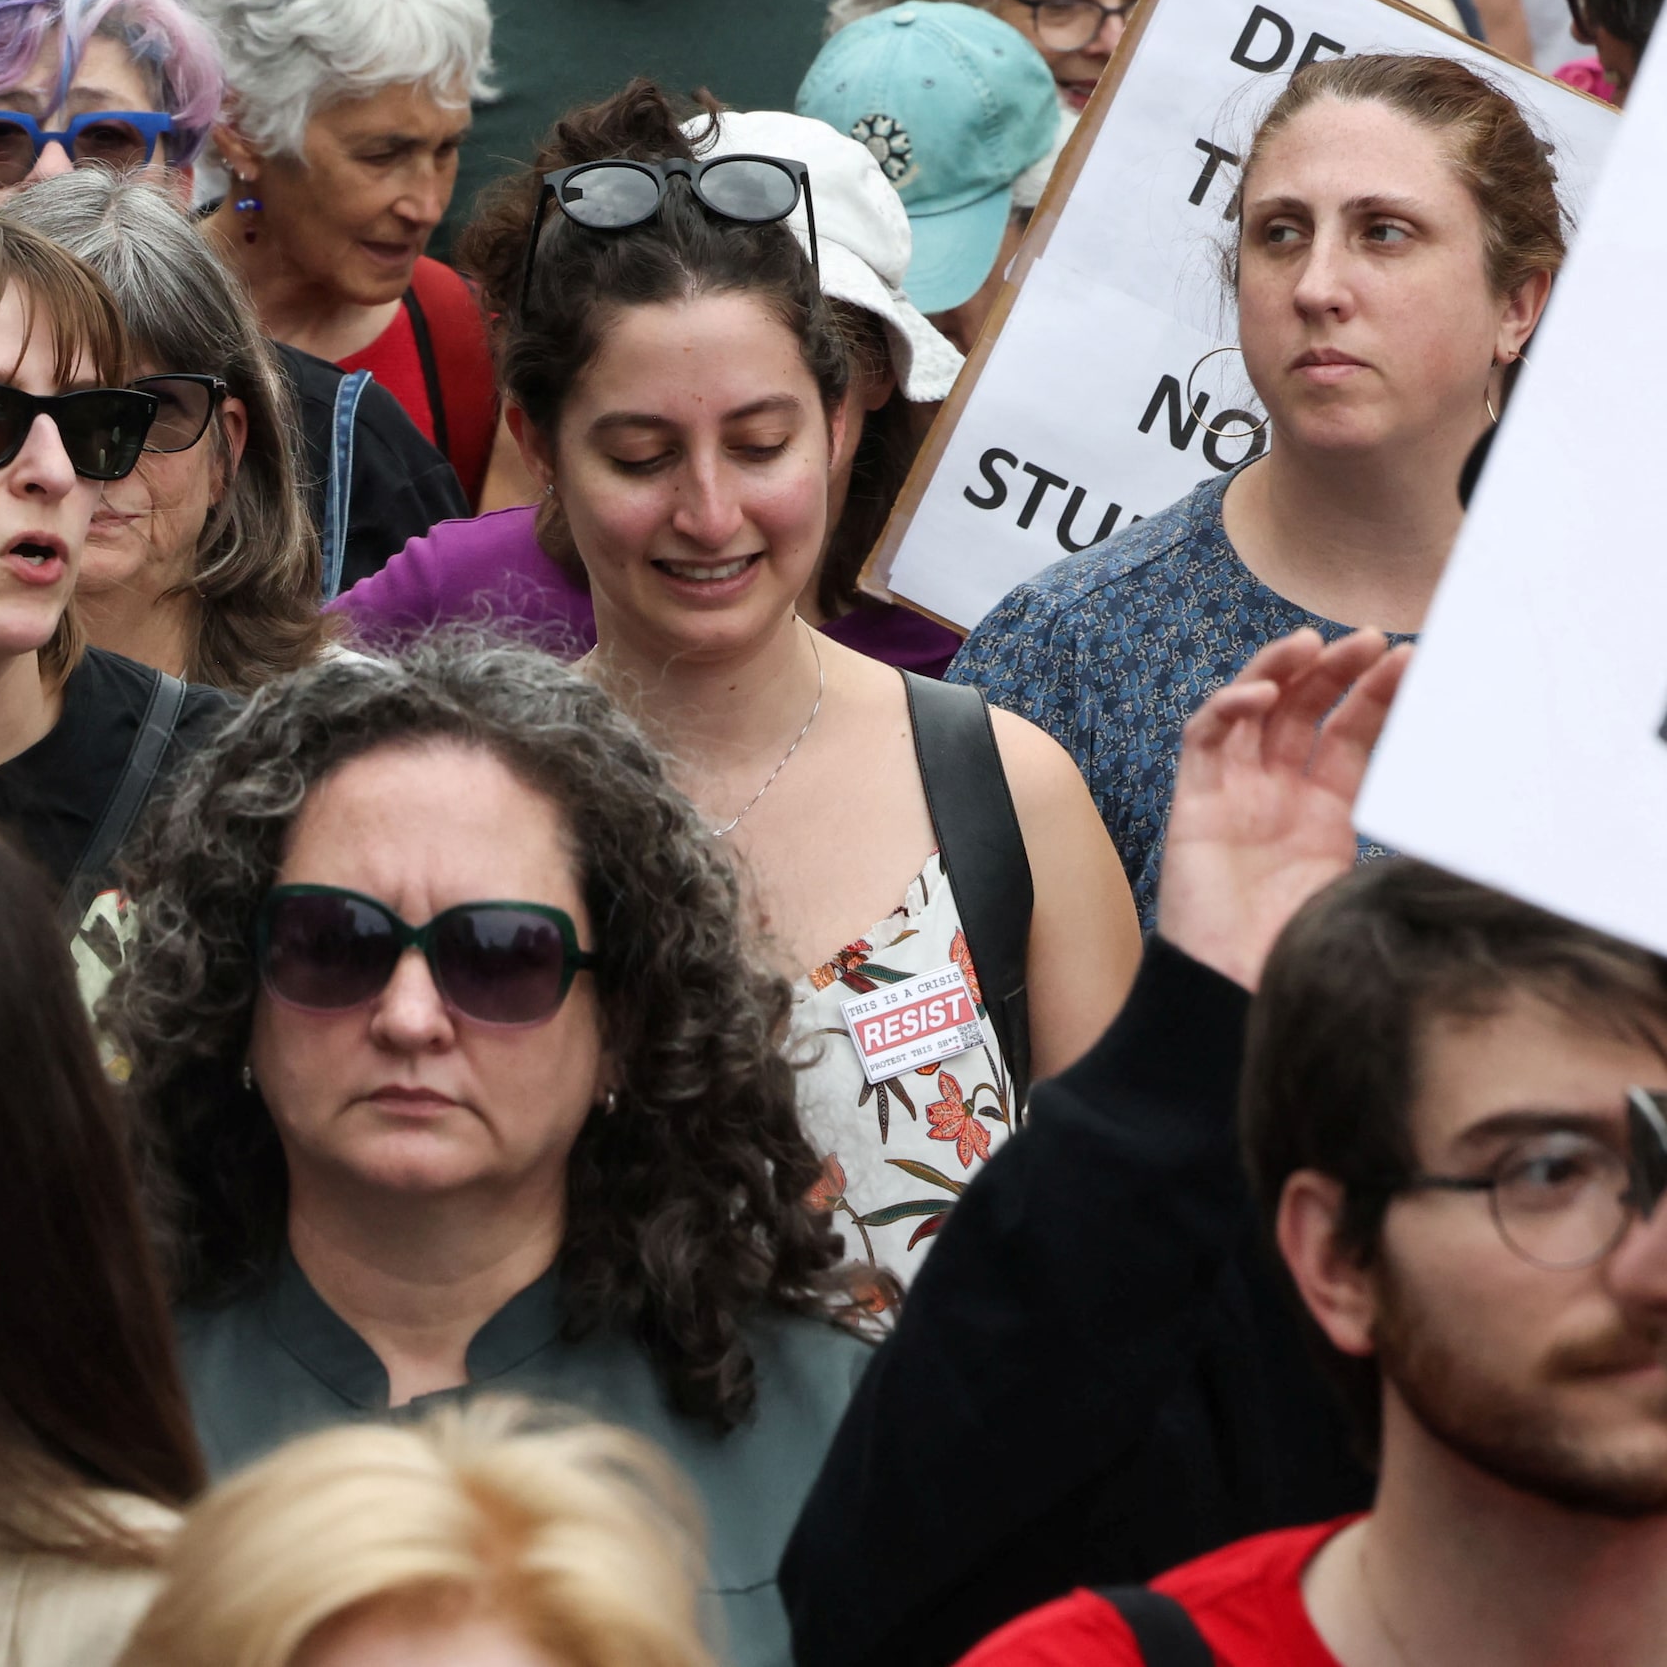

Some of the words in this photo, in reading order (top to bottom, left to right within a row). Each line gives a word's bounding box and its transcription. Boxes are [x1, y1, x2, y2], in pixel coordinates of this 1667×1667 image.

[848, 1000, 877, 1018] THIS
[885, 995, 899, 1006] IS
[904, 988, 913, 999] A
[917, 971, 962, 994] CRISIS
[863, 992, 966, 1052] RESIST
[869, 1052, 908, 1072] PROTEST
[911, 1043, 933, 1058] THIS
